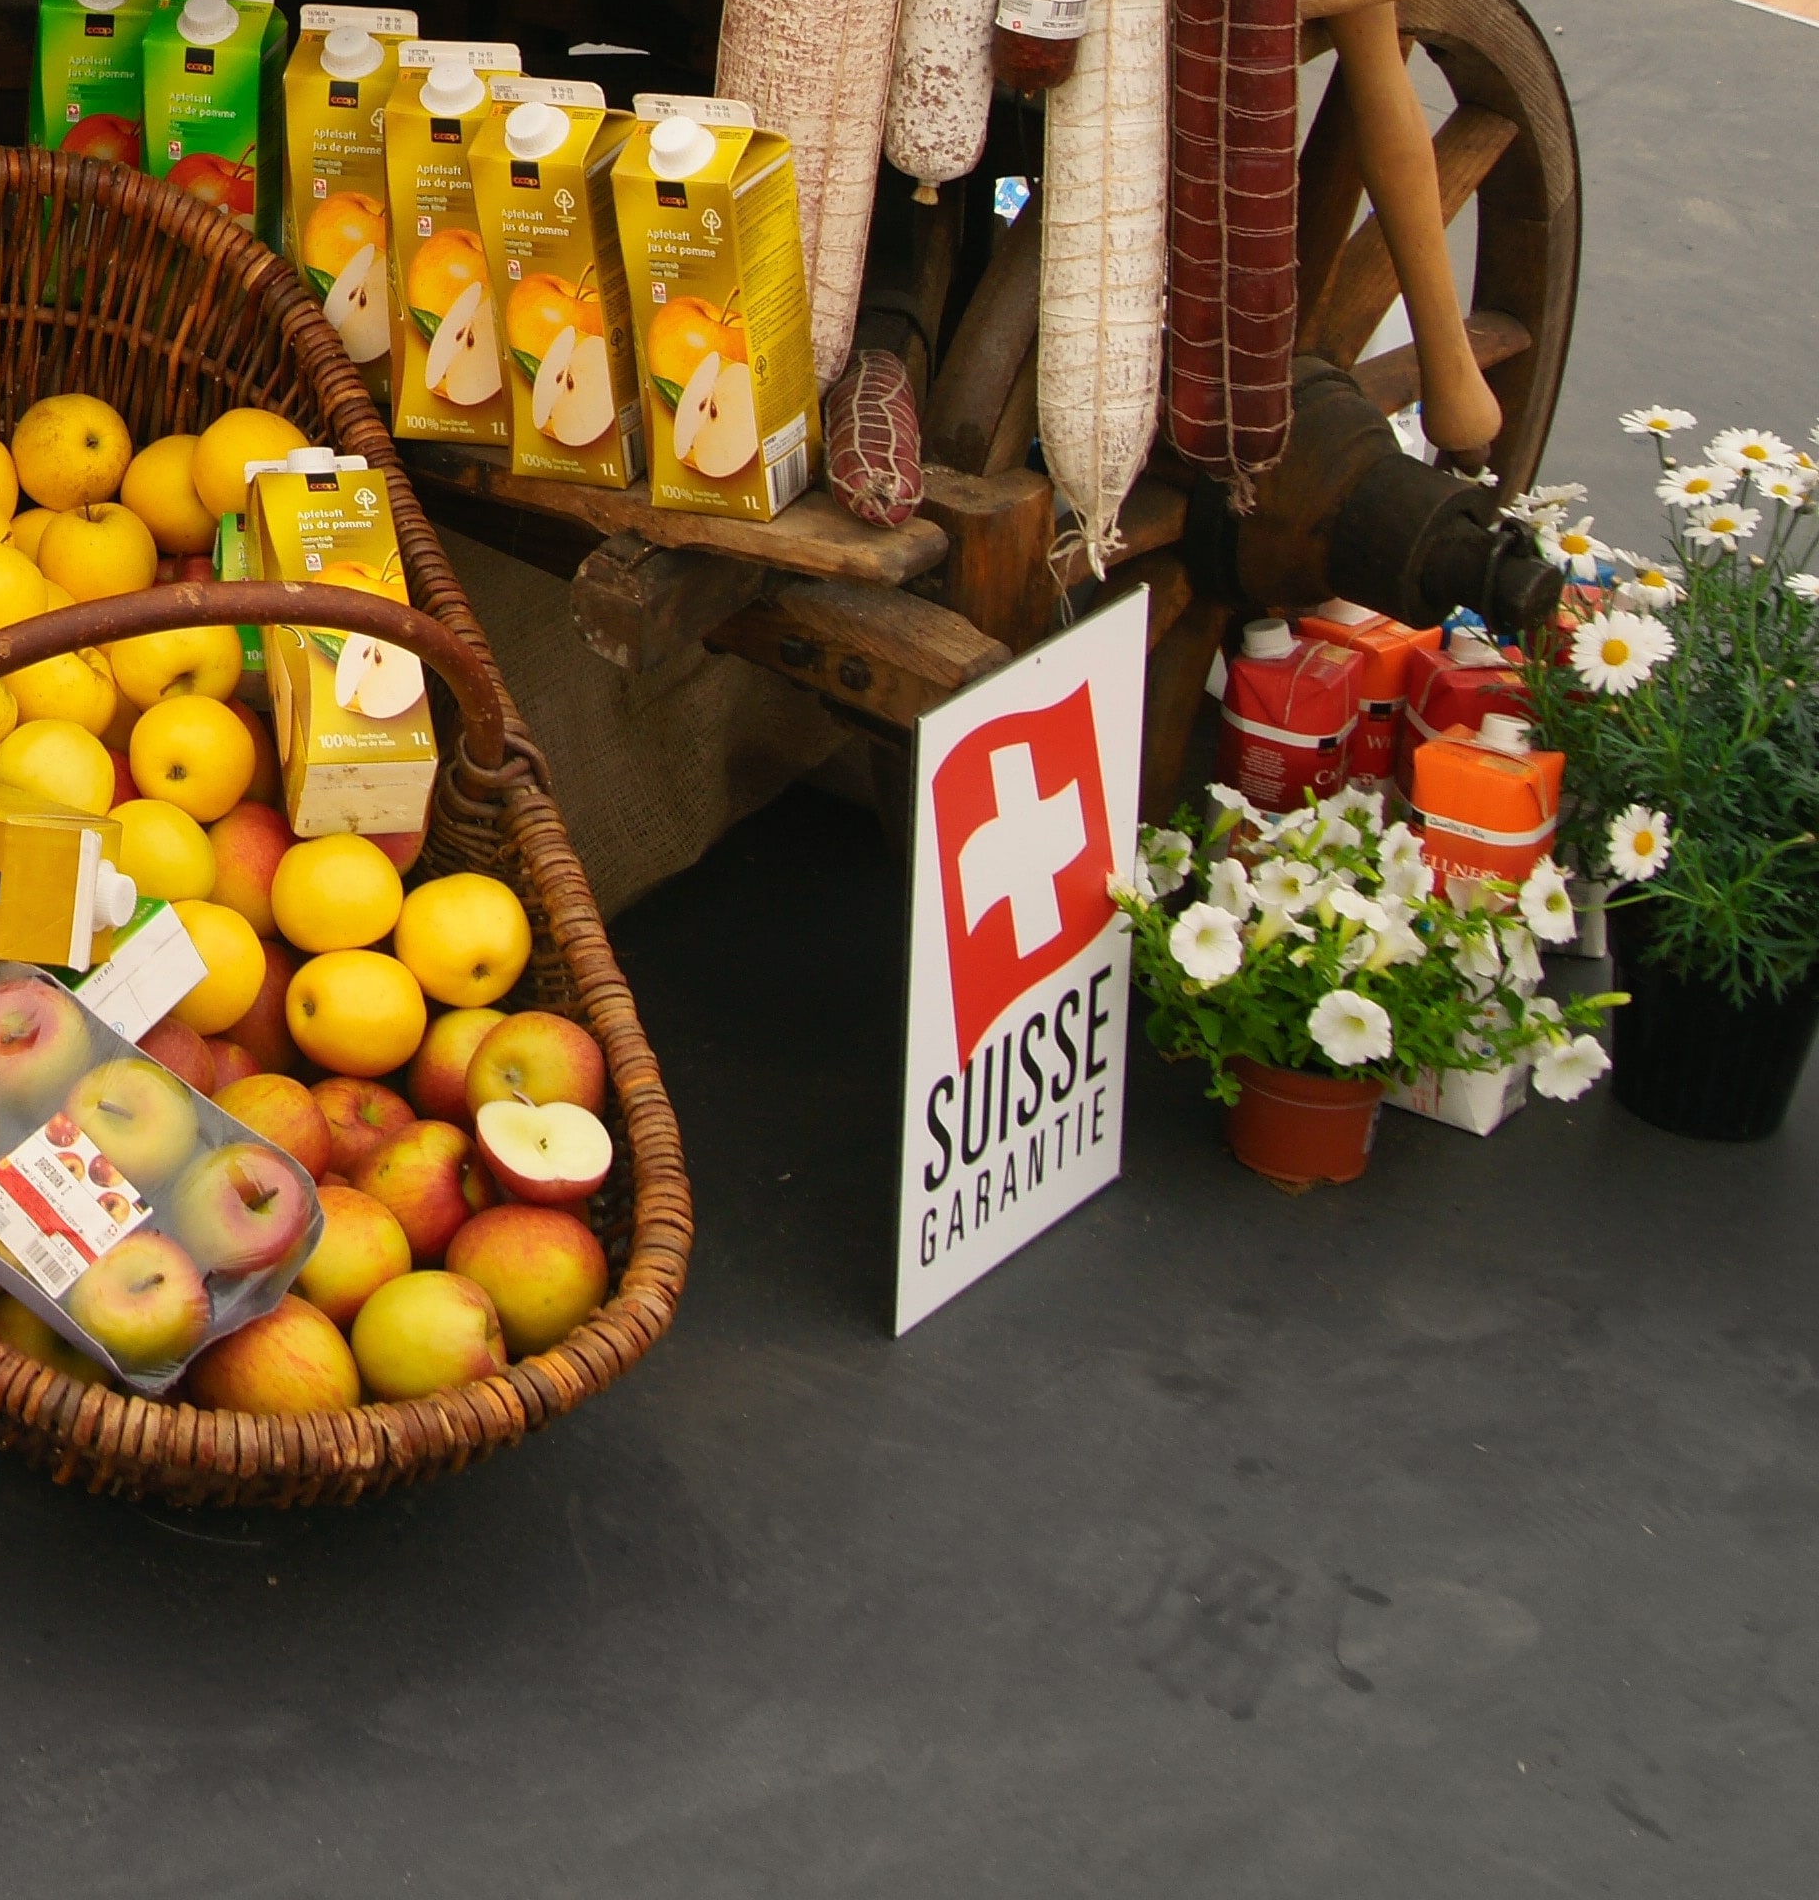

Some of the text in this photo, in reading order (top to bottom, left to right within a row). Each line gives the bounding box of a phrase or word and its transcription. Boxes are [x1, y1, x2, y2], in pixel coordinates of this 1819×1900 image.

[186, 63, 212, 73] coop
[169, 92, 212, 104] Apfelsaft
[330, 96, 358, 106] coop
[169, 104, 236, 120] jus de pomme
[314, 128, 357, 141] Apfelsaft
[314, 141, 383, 156] jus de pomme
[416, 163, 462, 176] Apfelsaft
[416, 177, 447, 188] jus de
[502, 209, 543, 221] Apfelsaft
[503, 222, 570, 237] jus de pomme
[647, 228, 691, 241] Apfelsaft
[648, 242, 717, 258] jus de pomme
[406, 414, 439, 430] 100%
[520, 453, 553, 469] 100%
[309, 481, 338, 491] coop
[661, 485, 692, 501] 100%
[297, 508, 343, 521] Apfelsaft
[299, 520, 373, 532] jus de pomme
[318, 731, 431, 749] 100% 1L
[1423, 853, 1503, 880] ELLNESS
[923, 964, 1113, 1193] SUISSE
[921, 1085, 1104, 1267] GARANTIE
